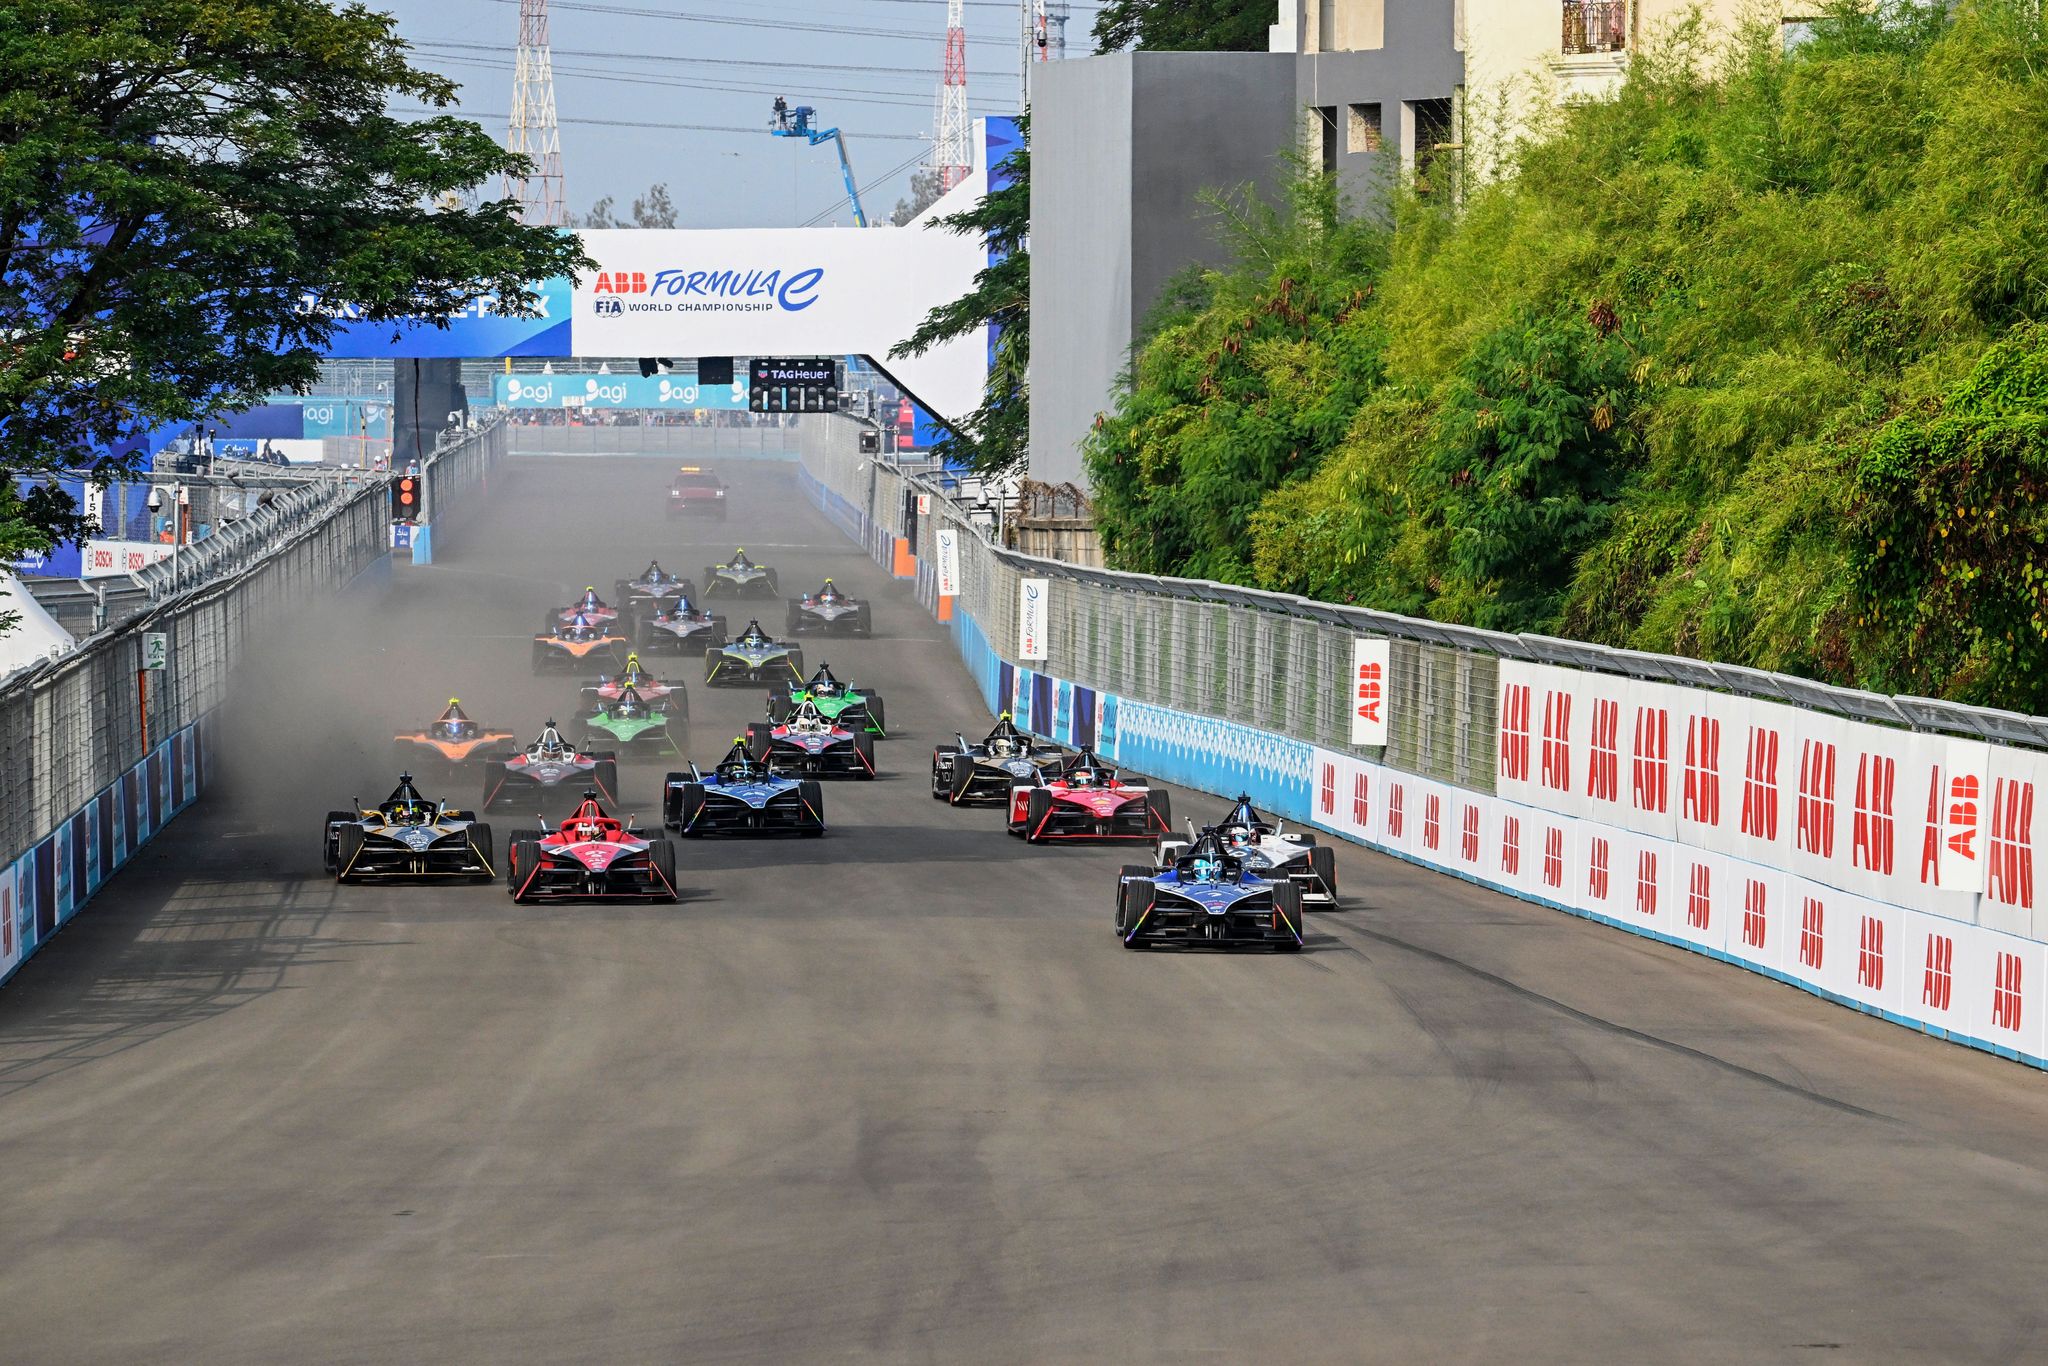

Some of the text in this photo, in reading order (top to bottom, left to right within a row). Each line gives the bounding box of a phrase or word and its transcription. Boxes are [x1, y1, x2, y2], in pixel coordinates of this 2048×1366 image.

[594, 272, 647, 293] ABB
[651, 269, 781, 297] FORMULA
[629, 303, 672, 311] WORLD
[677, 303, 773, 311] CHAMPIONSHIP
[95, 551, 113, 567] BOSCH
[128, 553, 145, 569] BOSCH
[1358, 662, 1381, 723] ABB
[1501, 684, 1530, 781] ABB
[1542, 691, 1571, 792] ABB
[1587, 699, 1618, 803] ABB
[1633, 707, 1668, 814] ABB
[1321, 762, 1335, 815] ABB
[1353, 773, 1368, 827] ABB
[1684, 715, 1720, 827] ABB
[1741, 726, 1778, 842] ABB
[1797, 739, 1836, 858] ABB
[1388, 783, 1403, 838] ABB
[1423, 793, 1440, 851] ABB
[1462, 804, 1479, 862] ABB
[1502, 815, 1519, 875] ABB
[1853, 752, 1895, 876] ABB
[1948, 774, 1979, 861] ABB
[1988, 777, 2034, 909] ABB
[1543, 826, 1562, 888] ABB
[1589, 837, 1608, 900] ABB
[1637, 850, 1657, 915] ABB
[1688, 863, 1710, 930] ABB
[1743, 879, 1766, 950] ABB
[1800, 896, 1824, 970] ABB
[1858, 915, 1884, 991] ABB
[1923, 933, 1952, 1011] ABB
[1992, 952, 2022, 1033] ABB
